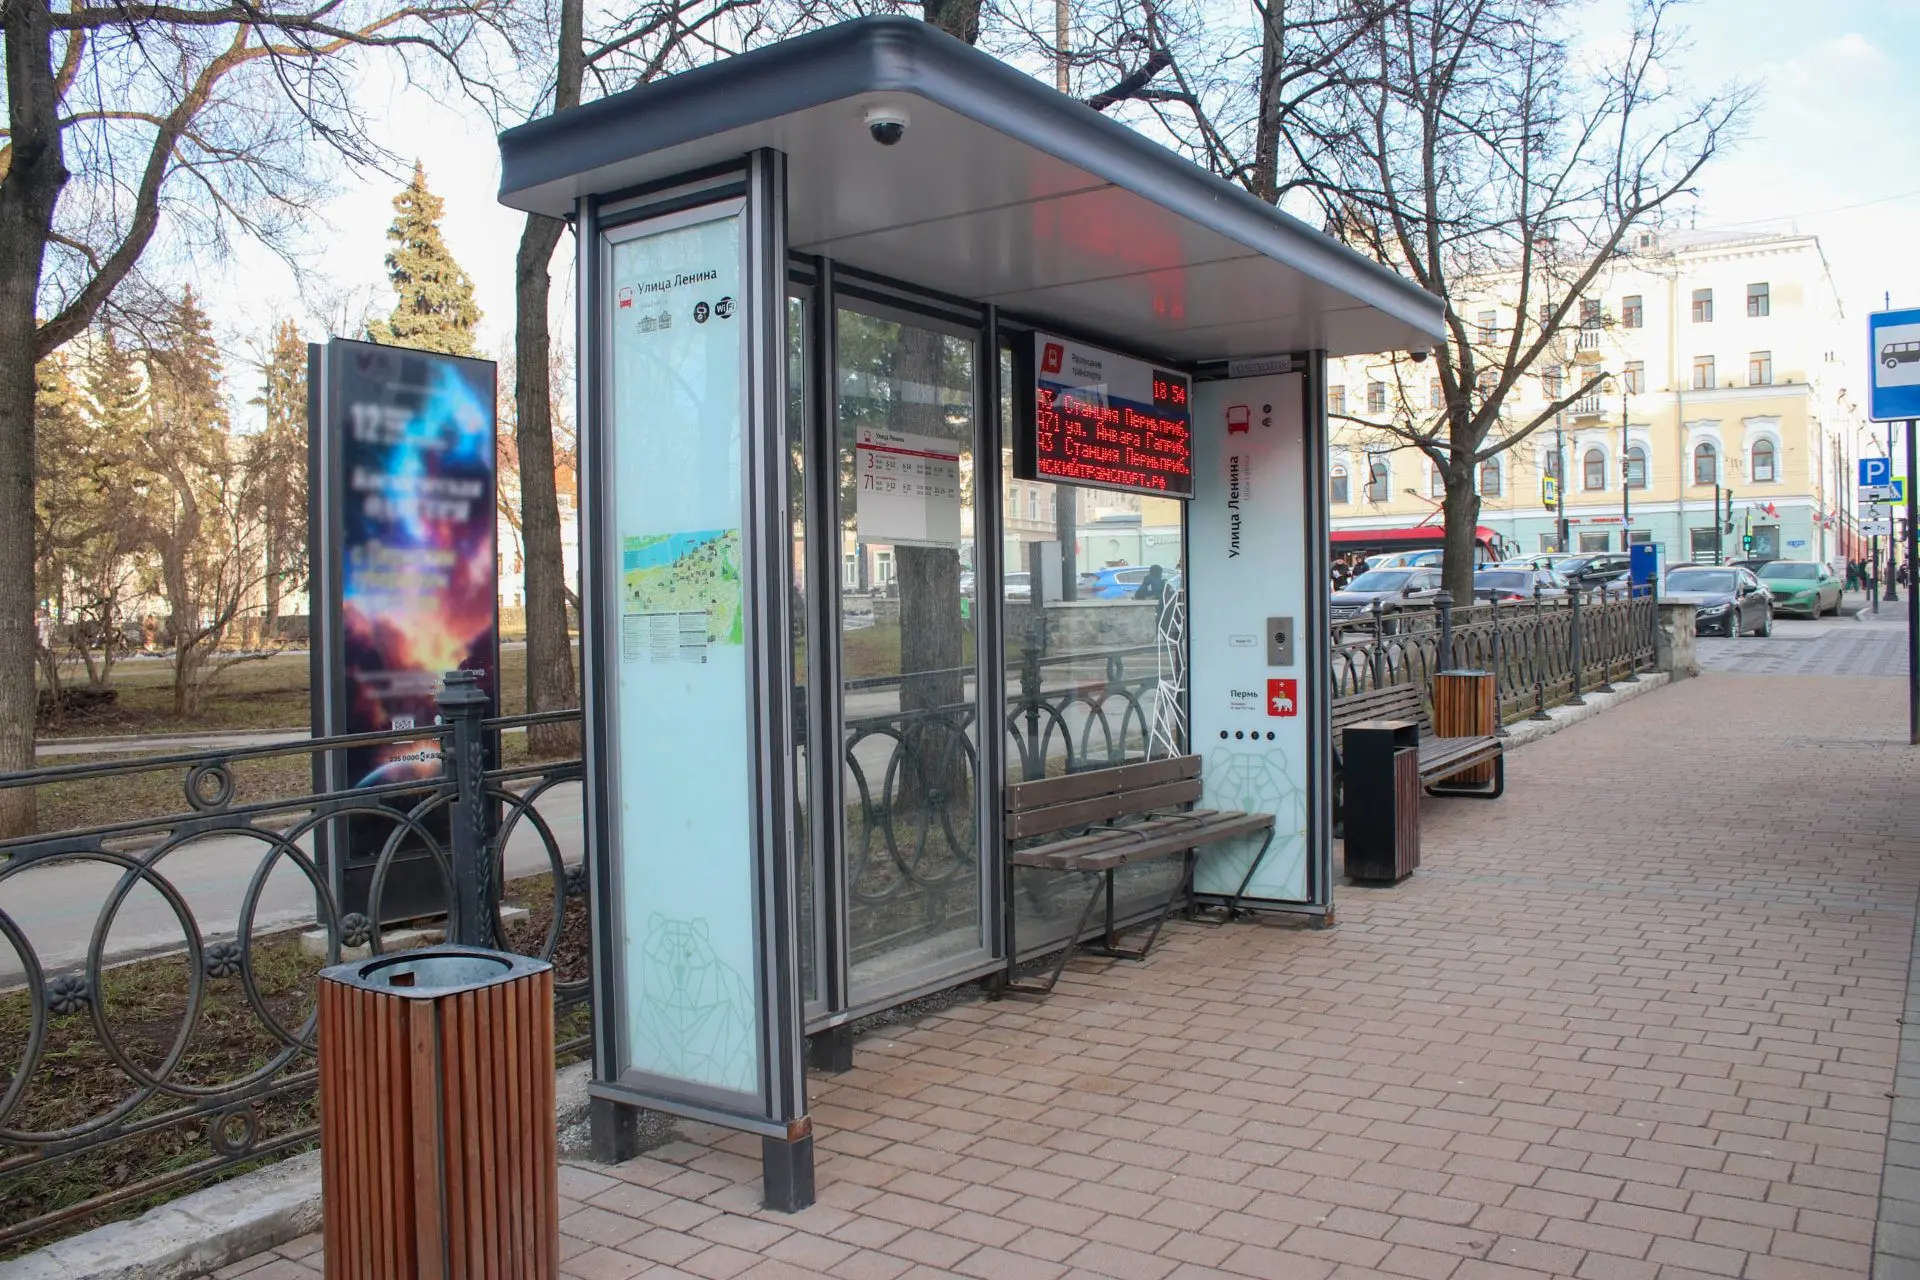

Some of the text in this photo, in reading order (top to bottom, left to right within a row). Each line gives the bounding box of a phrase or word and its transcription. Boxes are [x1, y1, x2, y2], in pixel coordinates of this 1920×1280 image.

[638, 269, 718, 295] Улица Ленина
[1064, 395, 1119, 424] Станция
[1065, 420, 1087, 437] ул.
[1096, 422, 1141, 448] Анвара
[867, 453, 874, 469] 3
[1064, 437, 1120, 464] Станция
[864, 474, 874, 490] 71
[1228, 455, 1241, 559] Улица Ленина
[1230, 690, 1258, 699] Пермь
